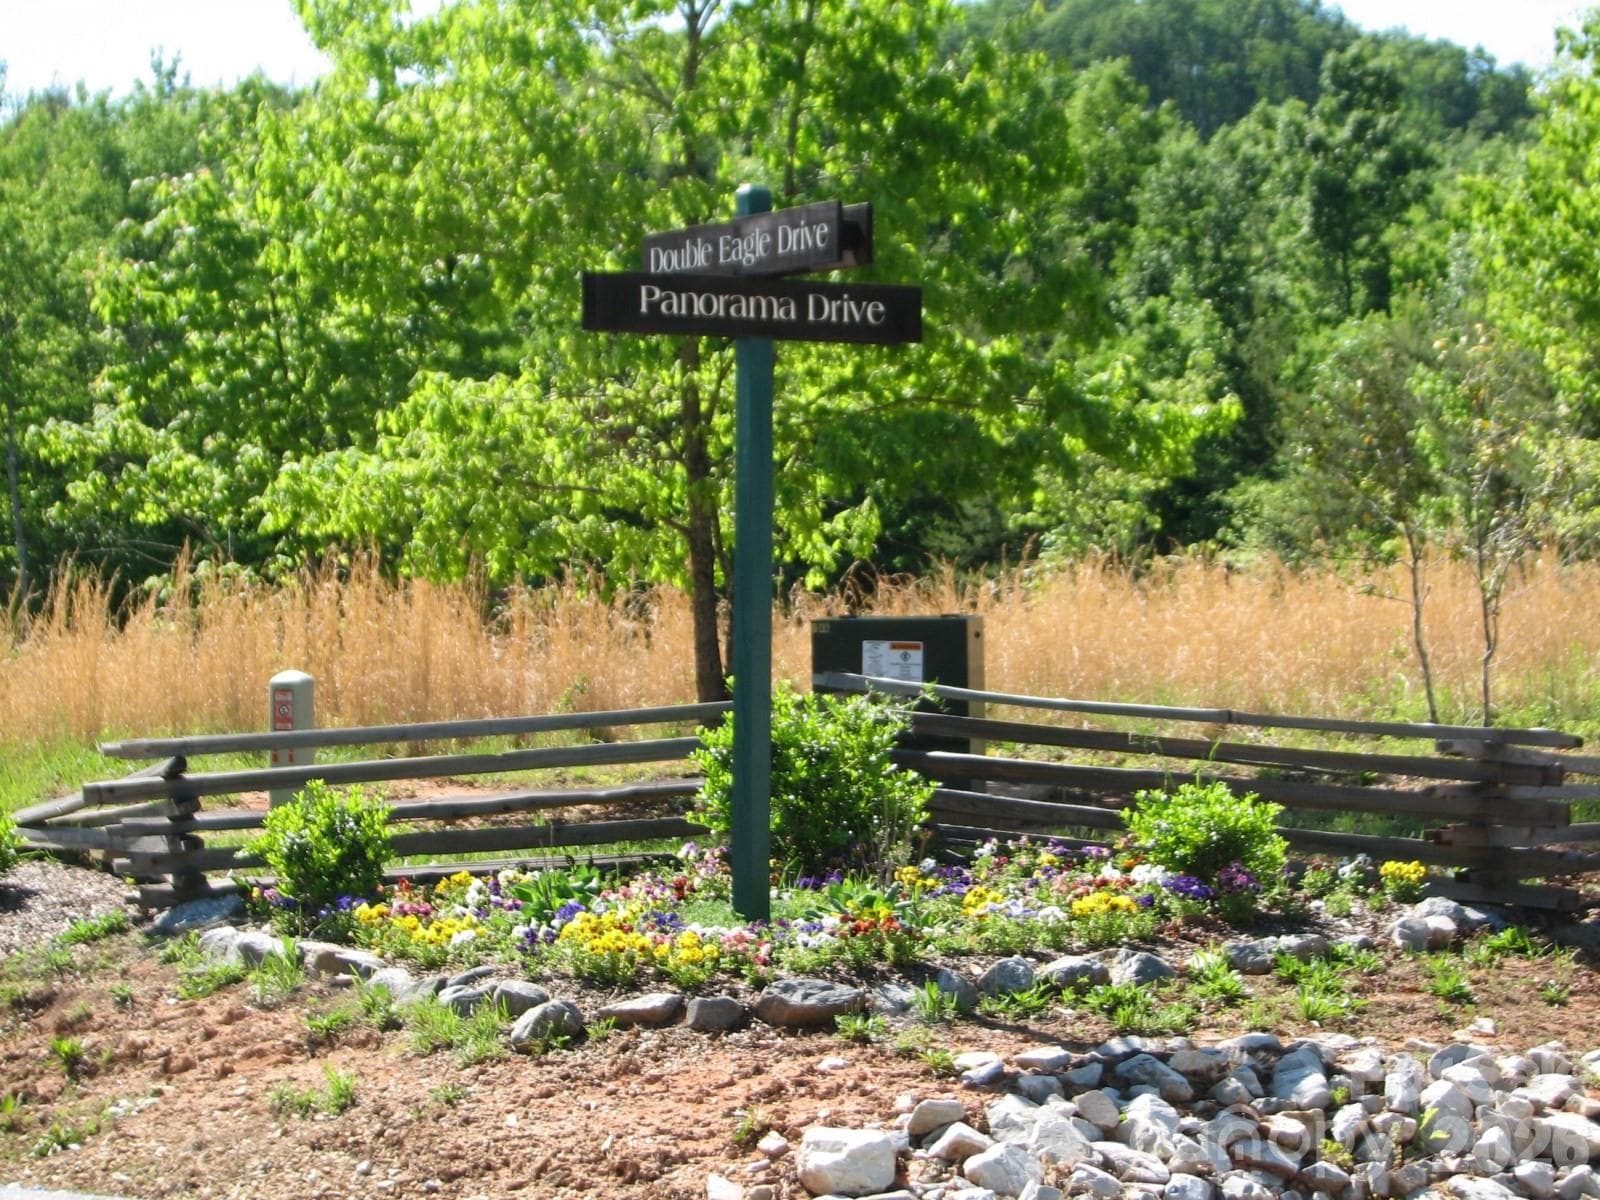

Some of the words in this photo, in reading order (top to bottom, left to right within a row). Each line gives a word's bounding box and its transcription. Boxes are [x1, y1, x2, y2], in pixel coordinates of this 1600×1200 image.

[649, 239, 712, 273] Double
[719, 227, 771, 266] Eagle
[777, 219, 829, 255] Drive
[640, 284, 796, 321] Panorama
[808, 293, 887, 326] Drive
